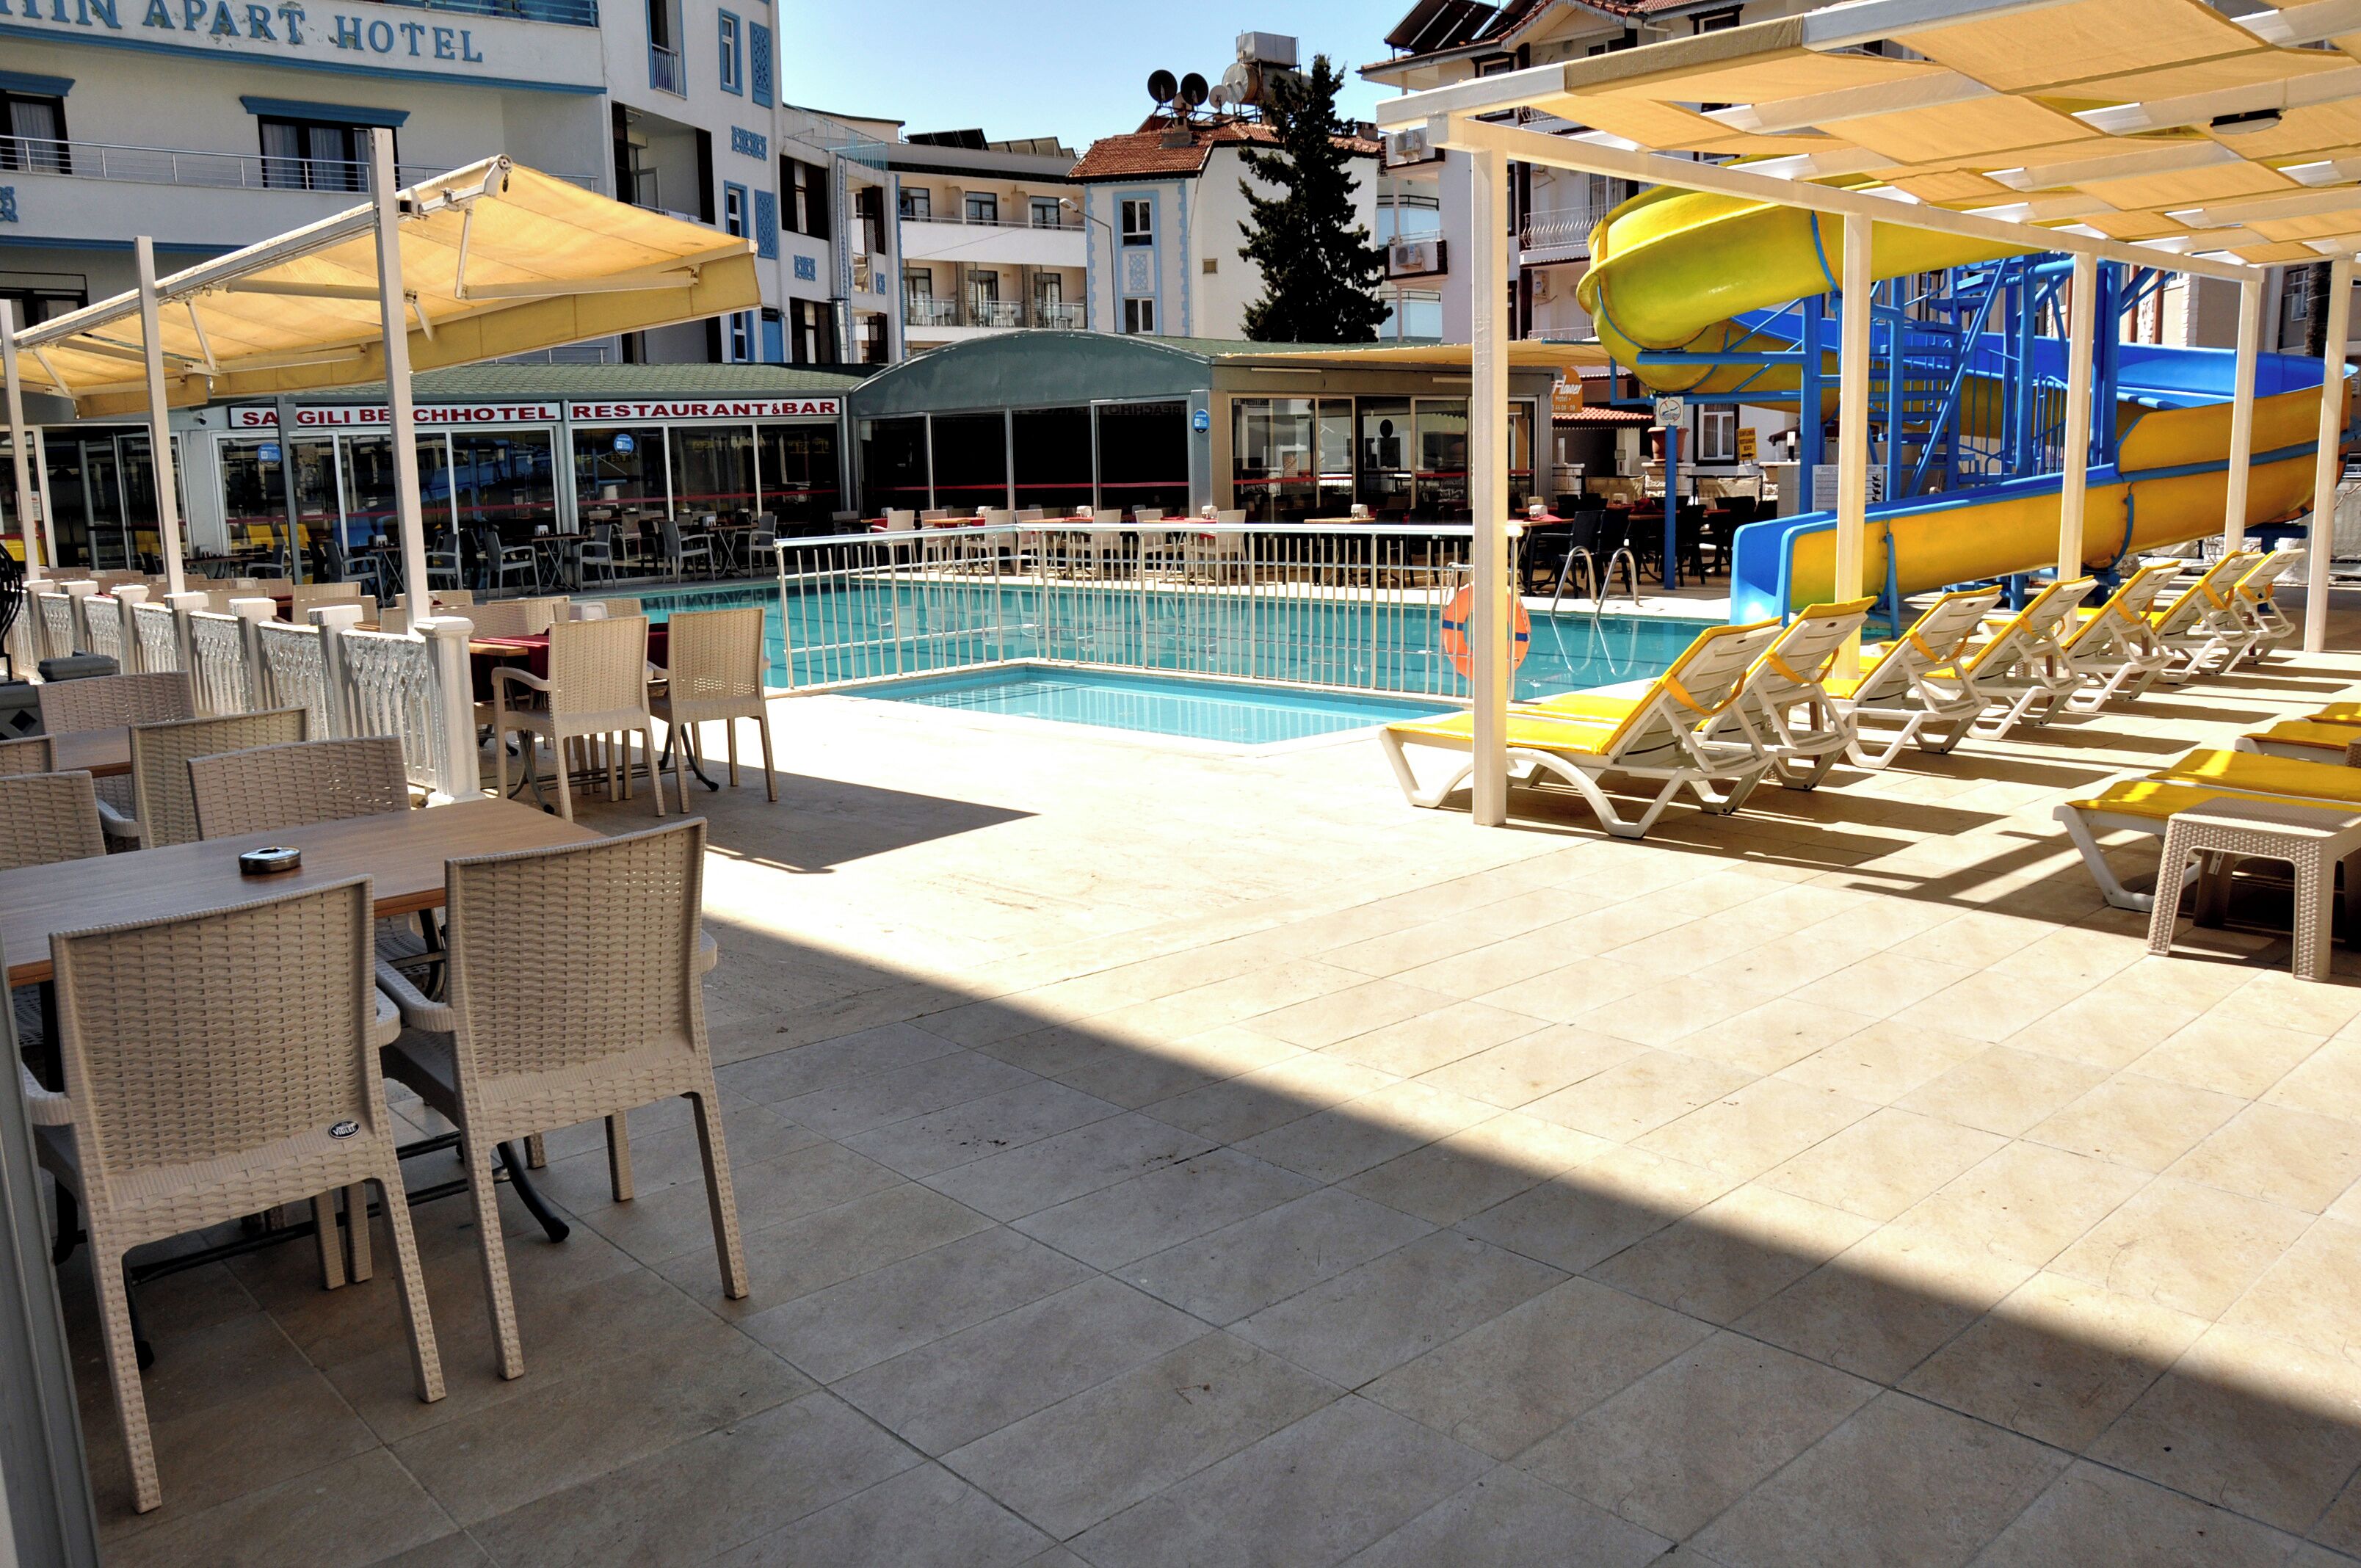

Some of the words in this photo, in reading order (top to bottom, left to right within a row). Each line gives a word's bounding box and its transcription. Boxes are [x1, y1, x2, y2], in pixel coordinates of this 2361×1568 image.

[142, 0, 306, 45] APART
[335, 15, 483, 62] HOTEL
[242, 410, 351, 425] SAGILI
[359, 406, 556, 423] BECHHOTEL
